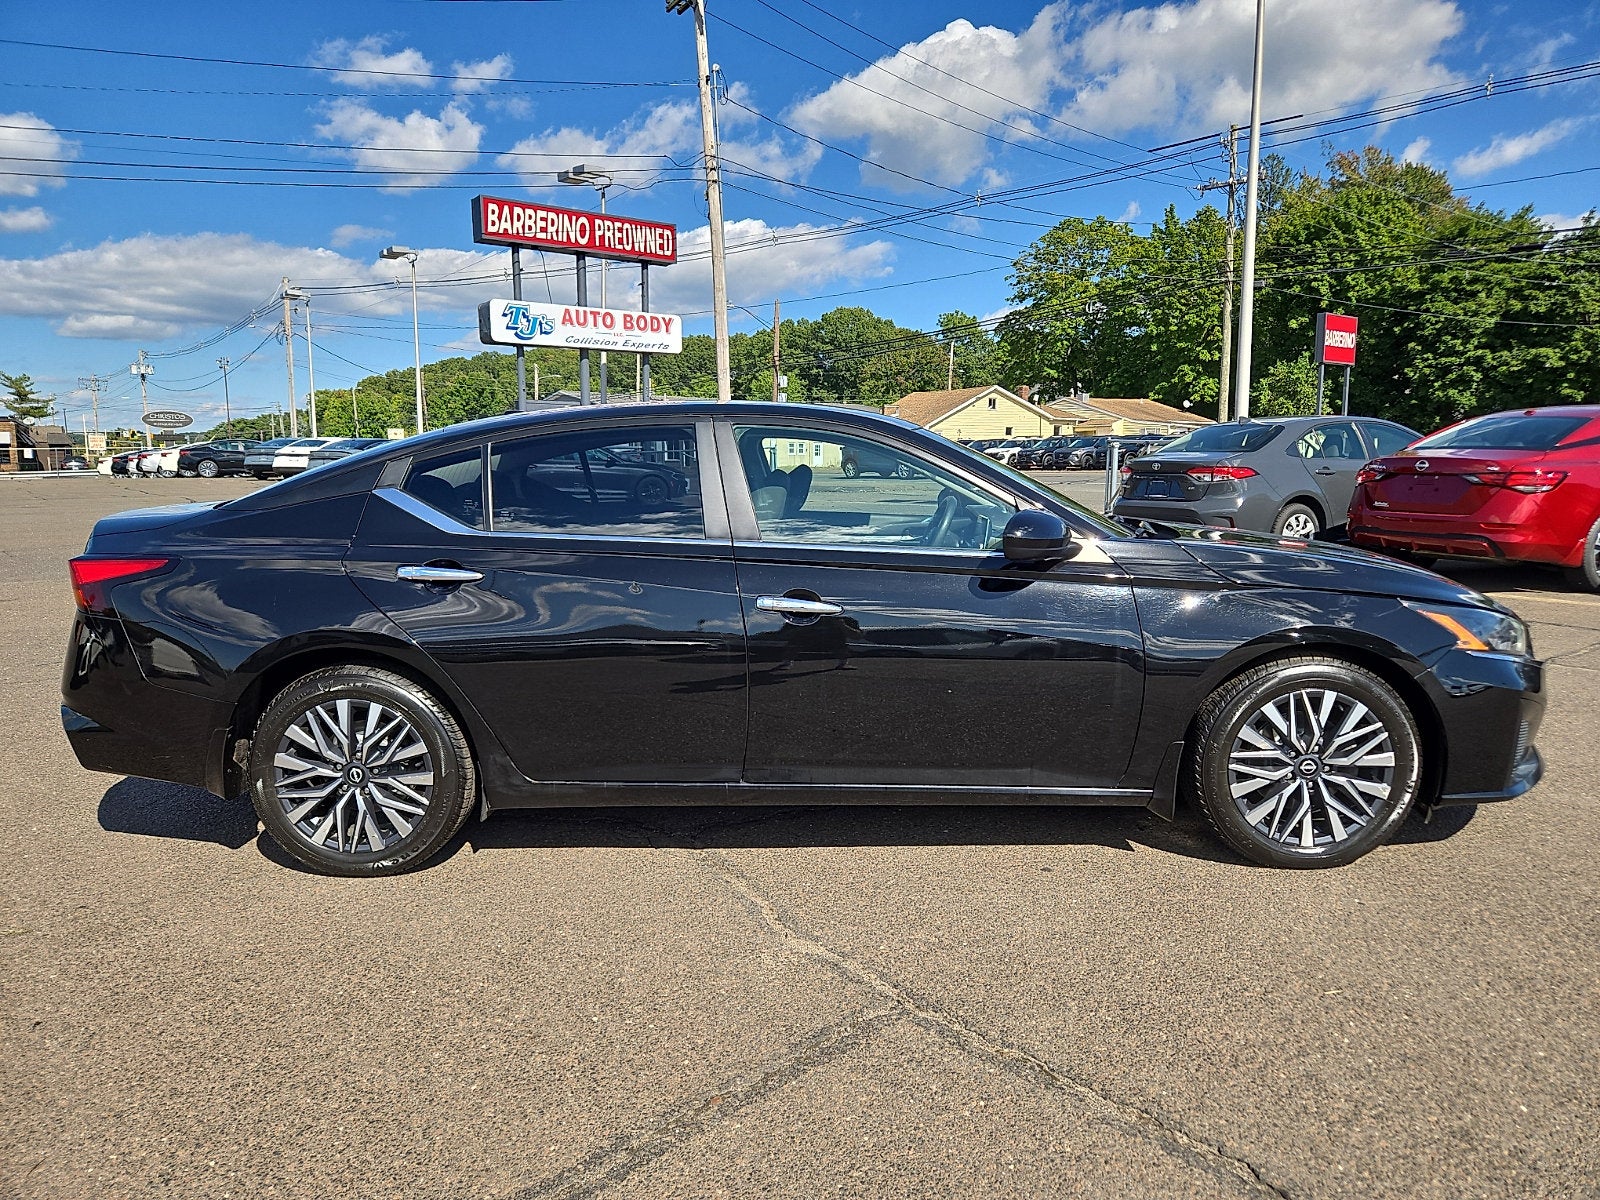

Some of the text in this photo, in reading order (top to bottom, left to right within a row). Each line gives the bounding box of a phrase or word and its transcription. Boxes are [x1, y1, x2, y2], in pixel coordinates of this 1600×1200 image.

[487, 203, 673, 256] BARBERINO PREOWNED
[561, 308, 674, 334] AUTO BODY
[565, 336, 670, 350] Collision Experts
[1325, 330, 1356, 348] BARBERINO
